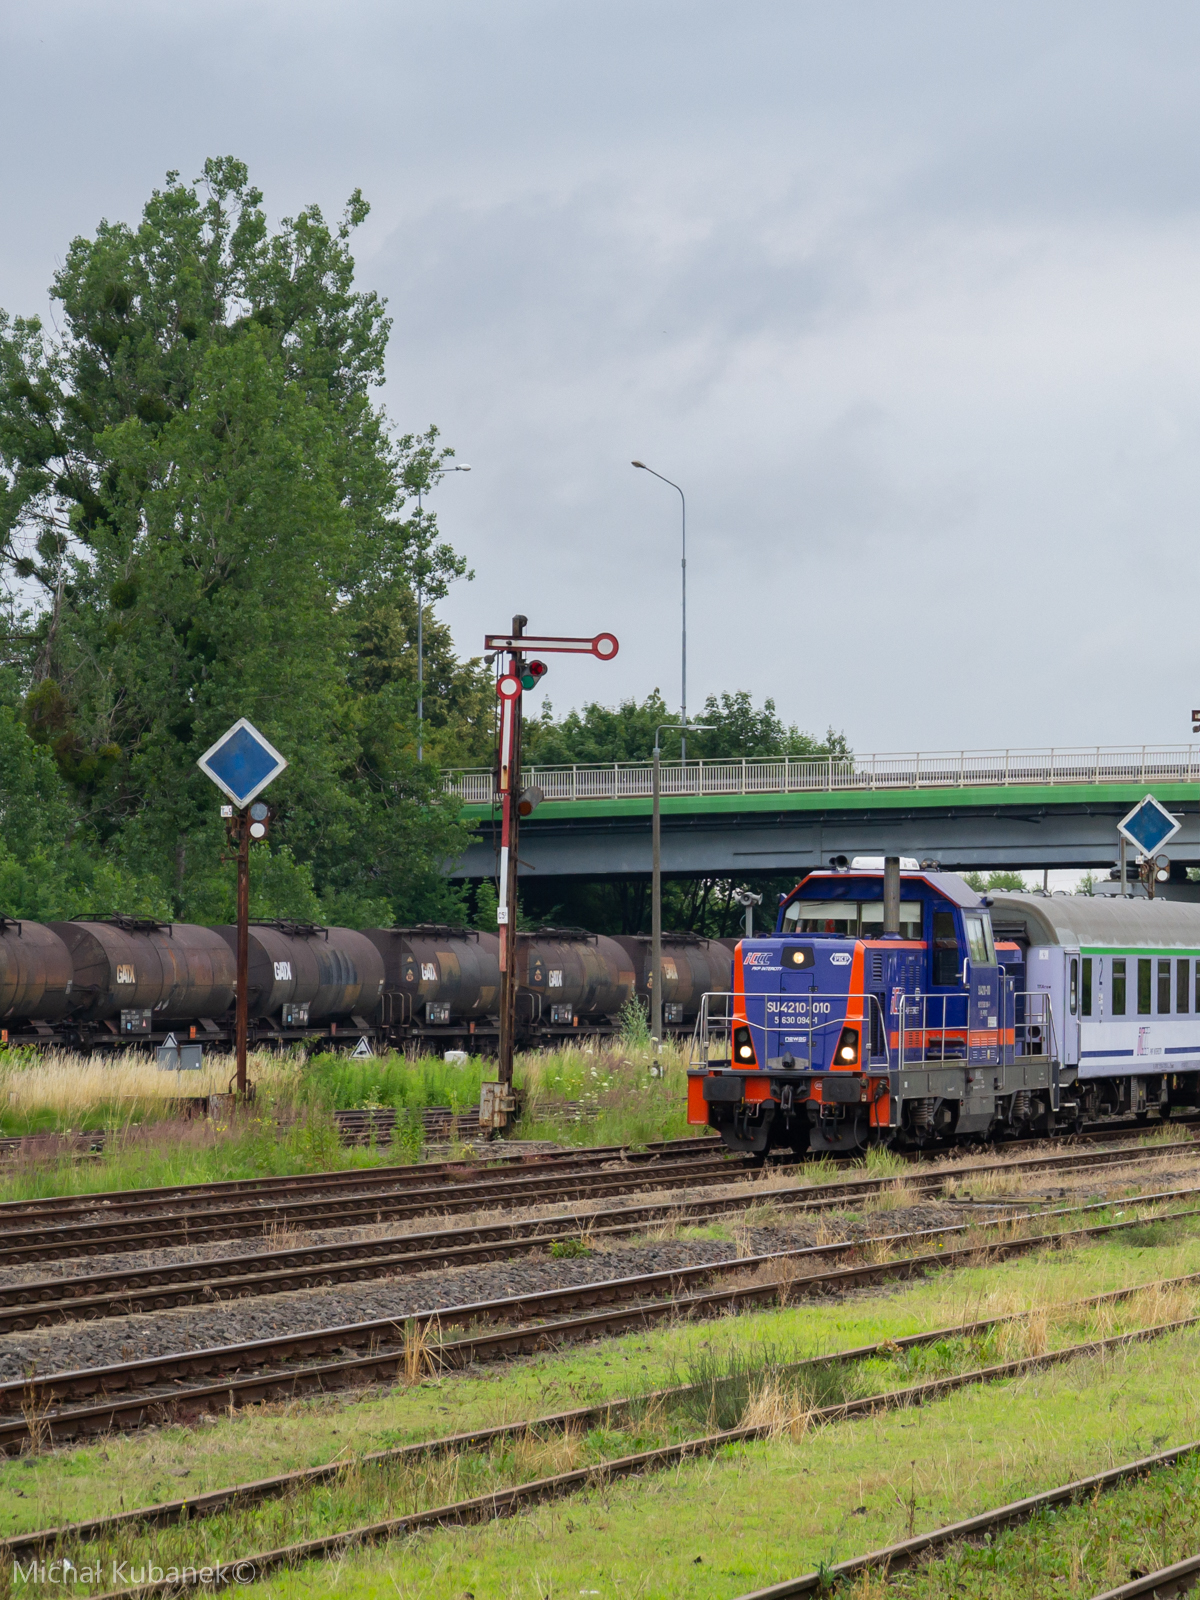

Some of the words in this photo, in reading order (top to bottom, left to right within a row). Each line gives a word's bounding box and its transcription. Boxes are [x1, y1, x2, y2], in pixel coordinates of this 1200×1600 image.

[117, 964, 135, 983] GATX
[274, 962, 292, 980] GATX
[421, 963, 438, 981] GATX
[549, 970, 562, 987] GATX
[767, 1002, 831, 1014] SU4210-010
[774, 1016, 780, 1024] 5
[781, 1016, 795, 1024] 630
